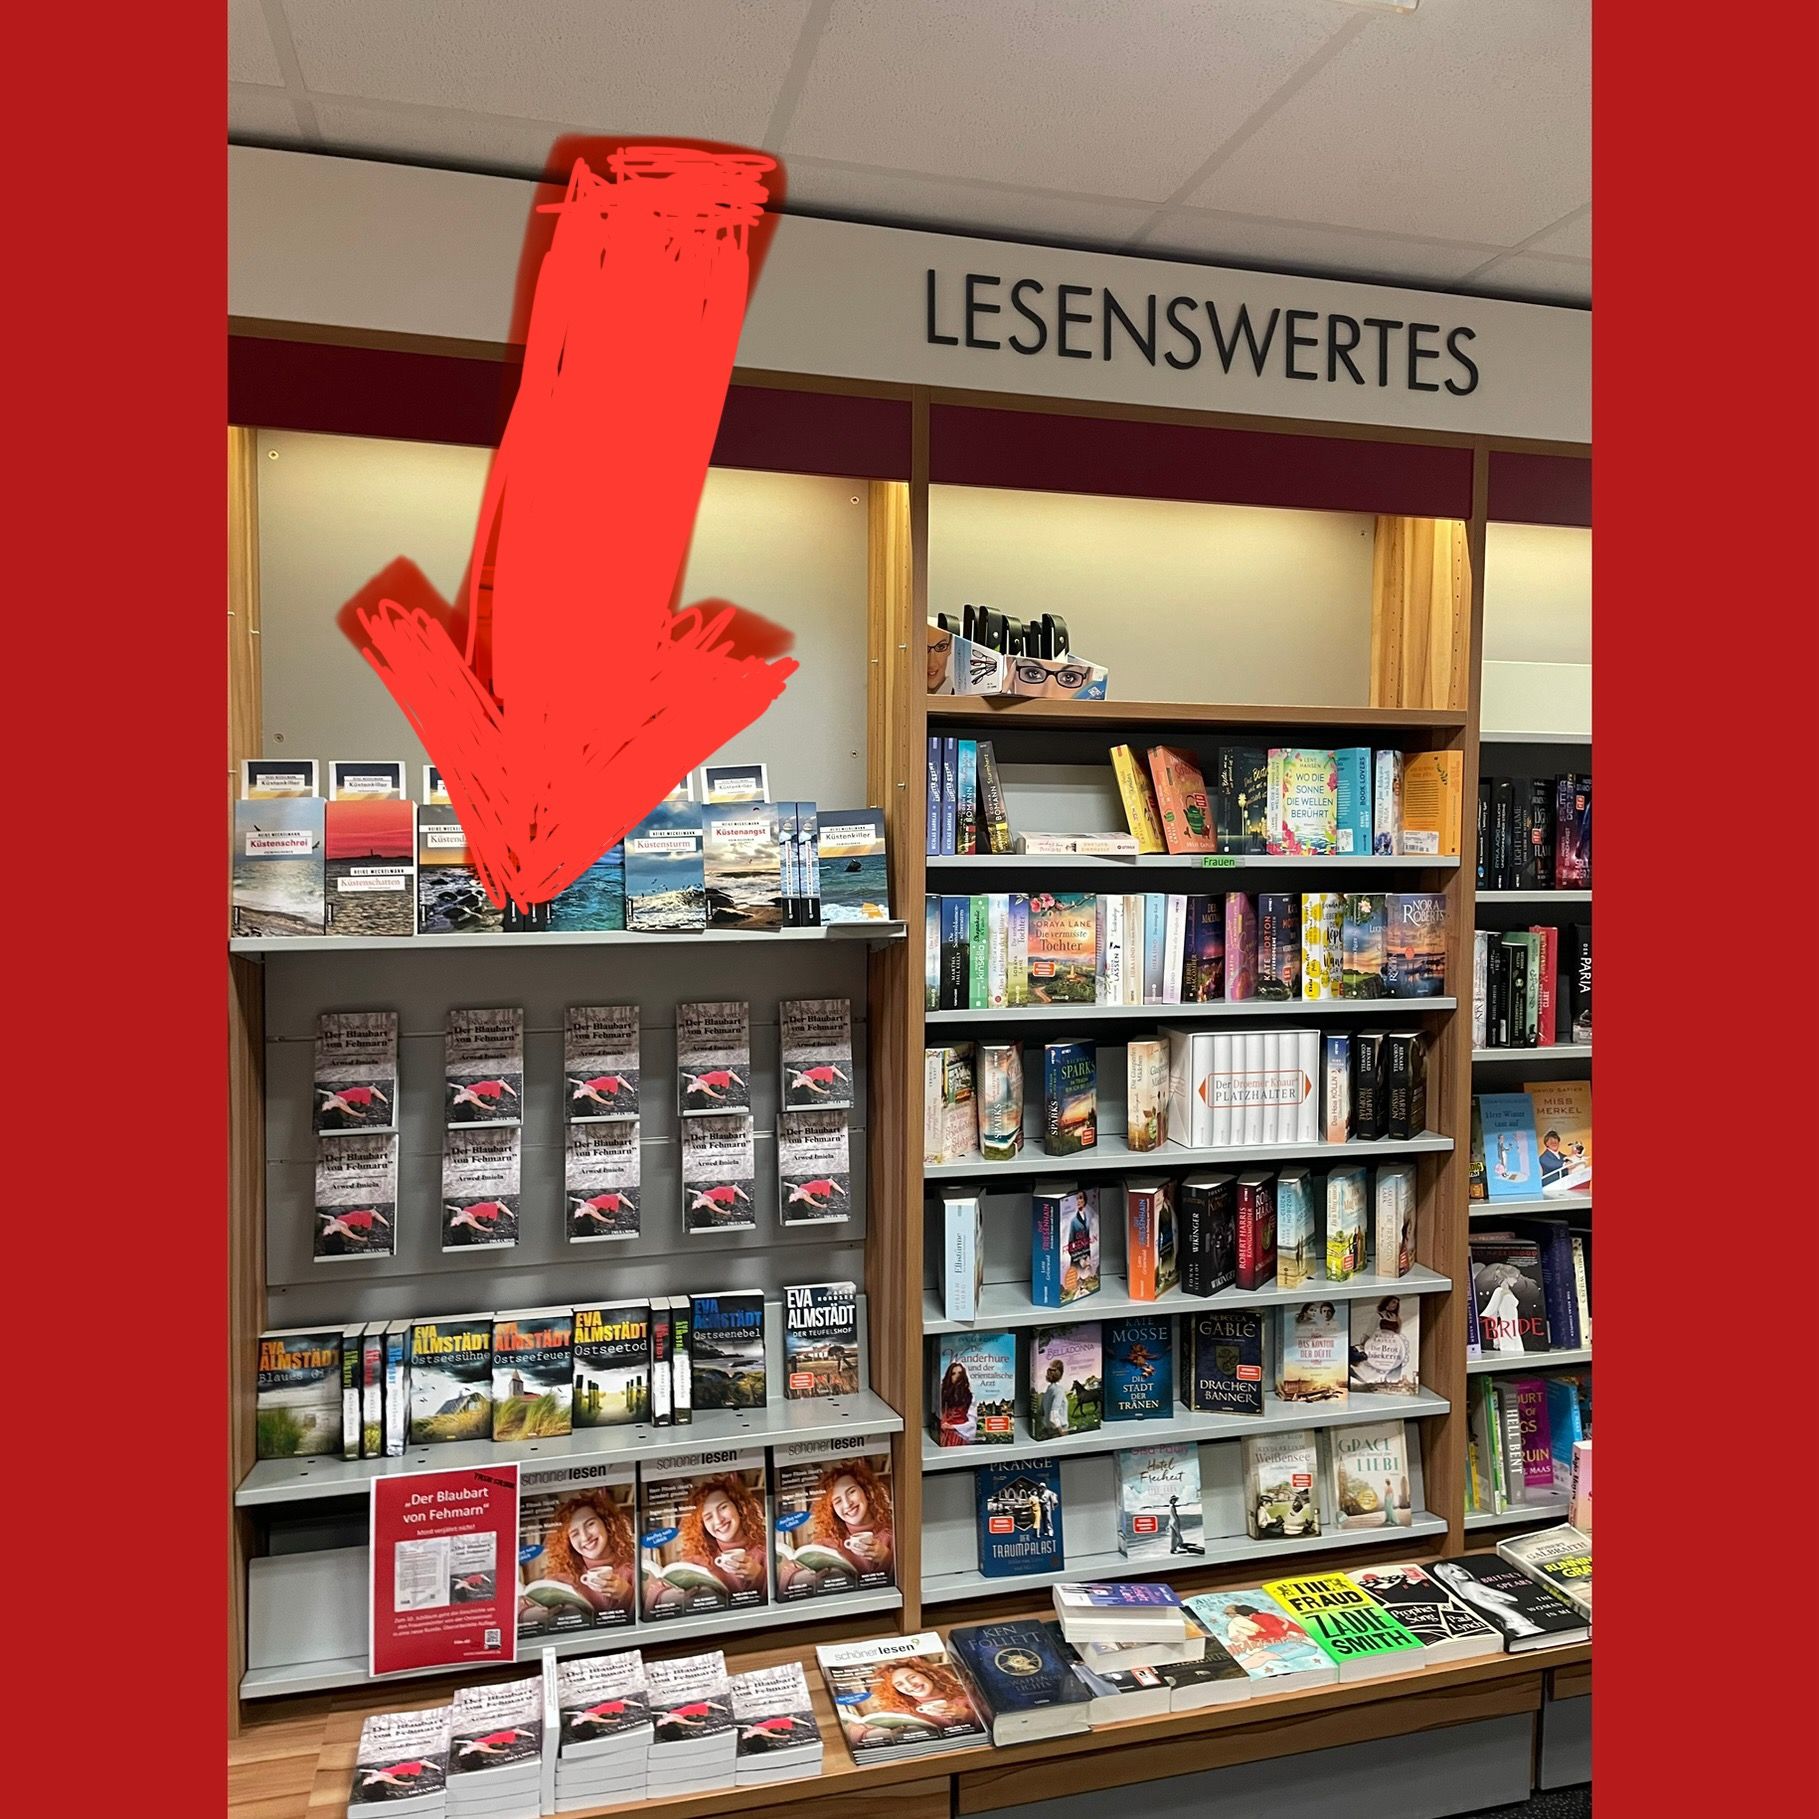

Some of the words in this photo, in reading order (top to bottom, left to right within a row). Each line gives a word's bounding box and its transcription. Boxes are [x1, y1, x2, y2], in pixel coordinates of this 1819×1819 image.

[927, 269, 1480, 396] LESENSWERTES
[1296, 773, 1309, 782] WO
[1311, 773, 1324, 782] DIE
[1295, 785, 1324, 793] SONNE
[991, 785, 1002, 821] BOMANN
[1286, 797, 1299, 806] DIE
[1301, 797, 1333, 806] WELLEN
[1291, 807, 1329, 818] BERÜHRT
[716, 829, 766, 837] Küstenangst
[826, 832, 870, 841] Küstenkiller
[250, 838, 308, 849] Küstenschrei
[637, 840, 691, 849] Küstensturm
[1203, 857, 1235, 867] Frauen
[341, 875, 401, 887] Küstenschatten
[1412, 900, 1439, 910] NORA
[1403, 904, 1445, 927] ROBERTS
[1036, 929, 1046, 938] Die
[1048, 930, 1087, 938] vermisste
[1040, 939, 1082, 952] Tochter
[1580, 957, 1591, 994] PARIA
[808, 1015, 843, 1023] Blaubart
[475, 1025, 515, 1033] Blaubart
[592, 1022, 631, 1030] Blaubart
[346, 1030, 387, 1038] Blaubart
[1061, 1060, 1096, 1080] SPARKS
[1216, 1080, 1231, 1089] Der
[1233, 1079, 1270, 1088] Droemer
[1215, 1090, 1296, 1102] PLATZHALTER
[709, 1132, 746, 1141] Blaubart
[805, 1127, 841, 1135] Blaubart
[593, 1139, 632, 1147] Blaubart
[472, 1146, 512, 1154] Blaubart
[346, 1152, 388, 1161] Blaubart
[1192, 1213, 1200, 1254] WIKINGER
[787, 1289, 812, 1308] EVA
[694, 1299, 718, 1314] EVA
[576, 1311, 601, 1327] EVA
[694, 1310, 762, 1328] ALMSTÄDT
[788, 1303, 855, 1328] ALMSTÄDT
[415, 1325, 437, 1338] EVA
[495, 1322, 518, 1334] EVA
[575, 1321, 647, 1343] ALMSTÄDT
[809, 1327, 853, 1336] TEUFELSHOF
[1479, 1316, 1544, 1340] BRIDE
[495, 1329, 571, 1351] ALMSTÄDT
[694, 1329, 761, 1340] Ostseenebel
[1113, 1328, 1168, 1343] MOSSE
[262, 1342, 285, 1354] EVA
[413, 1333, 490, 1354] ALMSTÄDT
[575, 1340, 648, 1356] Ostseetod
[1312, 1339, 1334, 1347] KONTOR
[1382, 1344, 1398, 1353] Brot
[411, 1351, 490, 1365] Ostseesühne
[494, 1351, 571, 1364] Ostseefeuer
[943, 1348, 1009, 1363] Wanderhure
[1047, 1344, 1094, 1360] BELLADONNA
[1300, 1350, 1311, 1358] DER
[1314, 1348, 1331, 1358] DÜFTE
[260, 1349, 340, 1371] ALMSTÄDT
[980, 1379, 995, 1387] Arzt
[1123, 1383, 1154, 1392] STADT
[1200, 1379, 1257, 1392] DRACHEN
[1205, 1391, 1258, 1405] BANNER
[1118, 1400, 1159, 1410] TRÄNEN
[1506, 1409, 1519, 1440] HELL
[1147, 1456, 1175, 1471] Hotel
[1256, 1452, 1311, 1463] Weißensee
[1509, 1444, 1523, 1474] BENT
[989, 1459, 1053, 1472] PRANGE
[1139, 1471, 1185, 1483] Freiheit
[437, 1488, 488, 1502] Blaubart
[403, 1512, 426, 1523] von
[992, 1539, 1056, 1559] TRAUMPALAST
[1526, 1542, 1587, 1561] GALBRAITH
[1480, 1572, 1523, 1584] BRITNEY
[1496, 1579, 1533, 1590] SPEARS
[1288, 1591, 1364, 1612] FRAUD
[1392, 1605, 1436, 1619] Prophet
[1526, 1603, 1563, 1613] WOMAN
[1305, 1607, 1394, 1638] ZADIE
[1404, 1612, 1439, 1624] Song
[1448, 1614, 1472, 1626] Paul
[982, 1625, 1017, 1637] KEN
[1452, 1620, 1485, 1631] Lynch
[968, 1631, 1041, 1651] FOLLETT
[1331, 1630, 1413, 1655] SMITH
[588, 1662, 634, 1674] Blaubart
[673, 1663, 717, 1676] Blaubart
[754, 1676, 796, 1688] Blaubart
[488, 1689, 533, 1701] Blaubart
[397, 1719, 443, 1729] Blaubart
